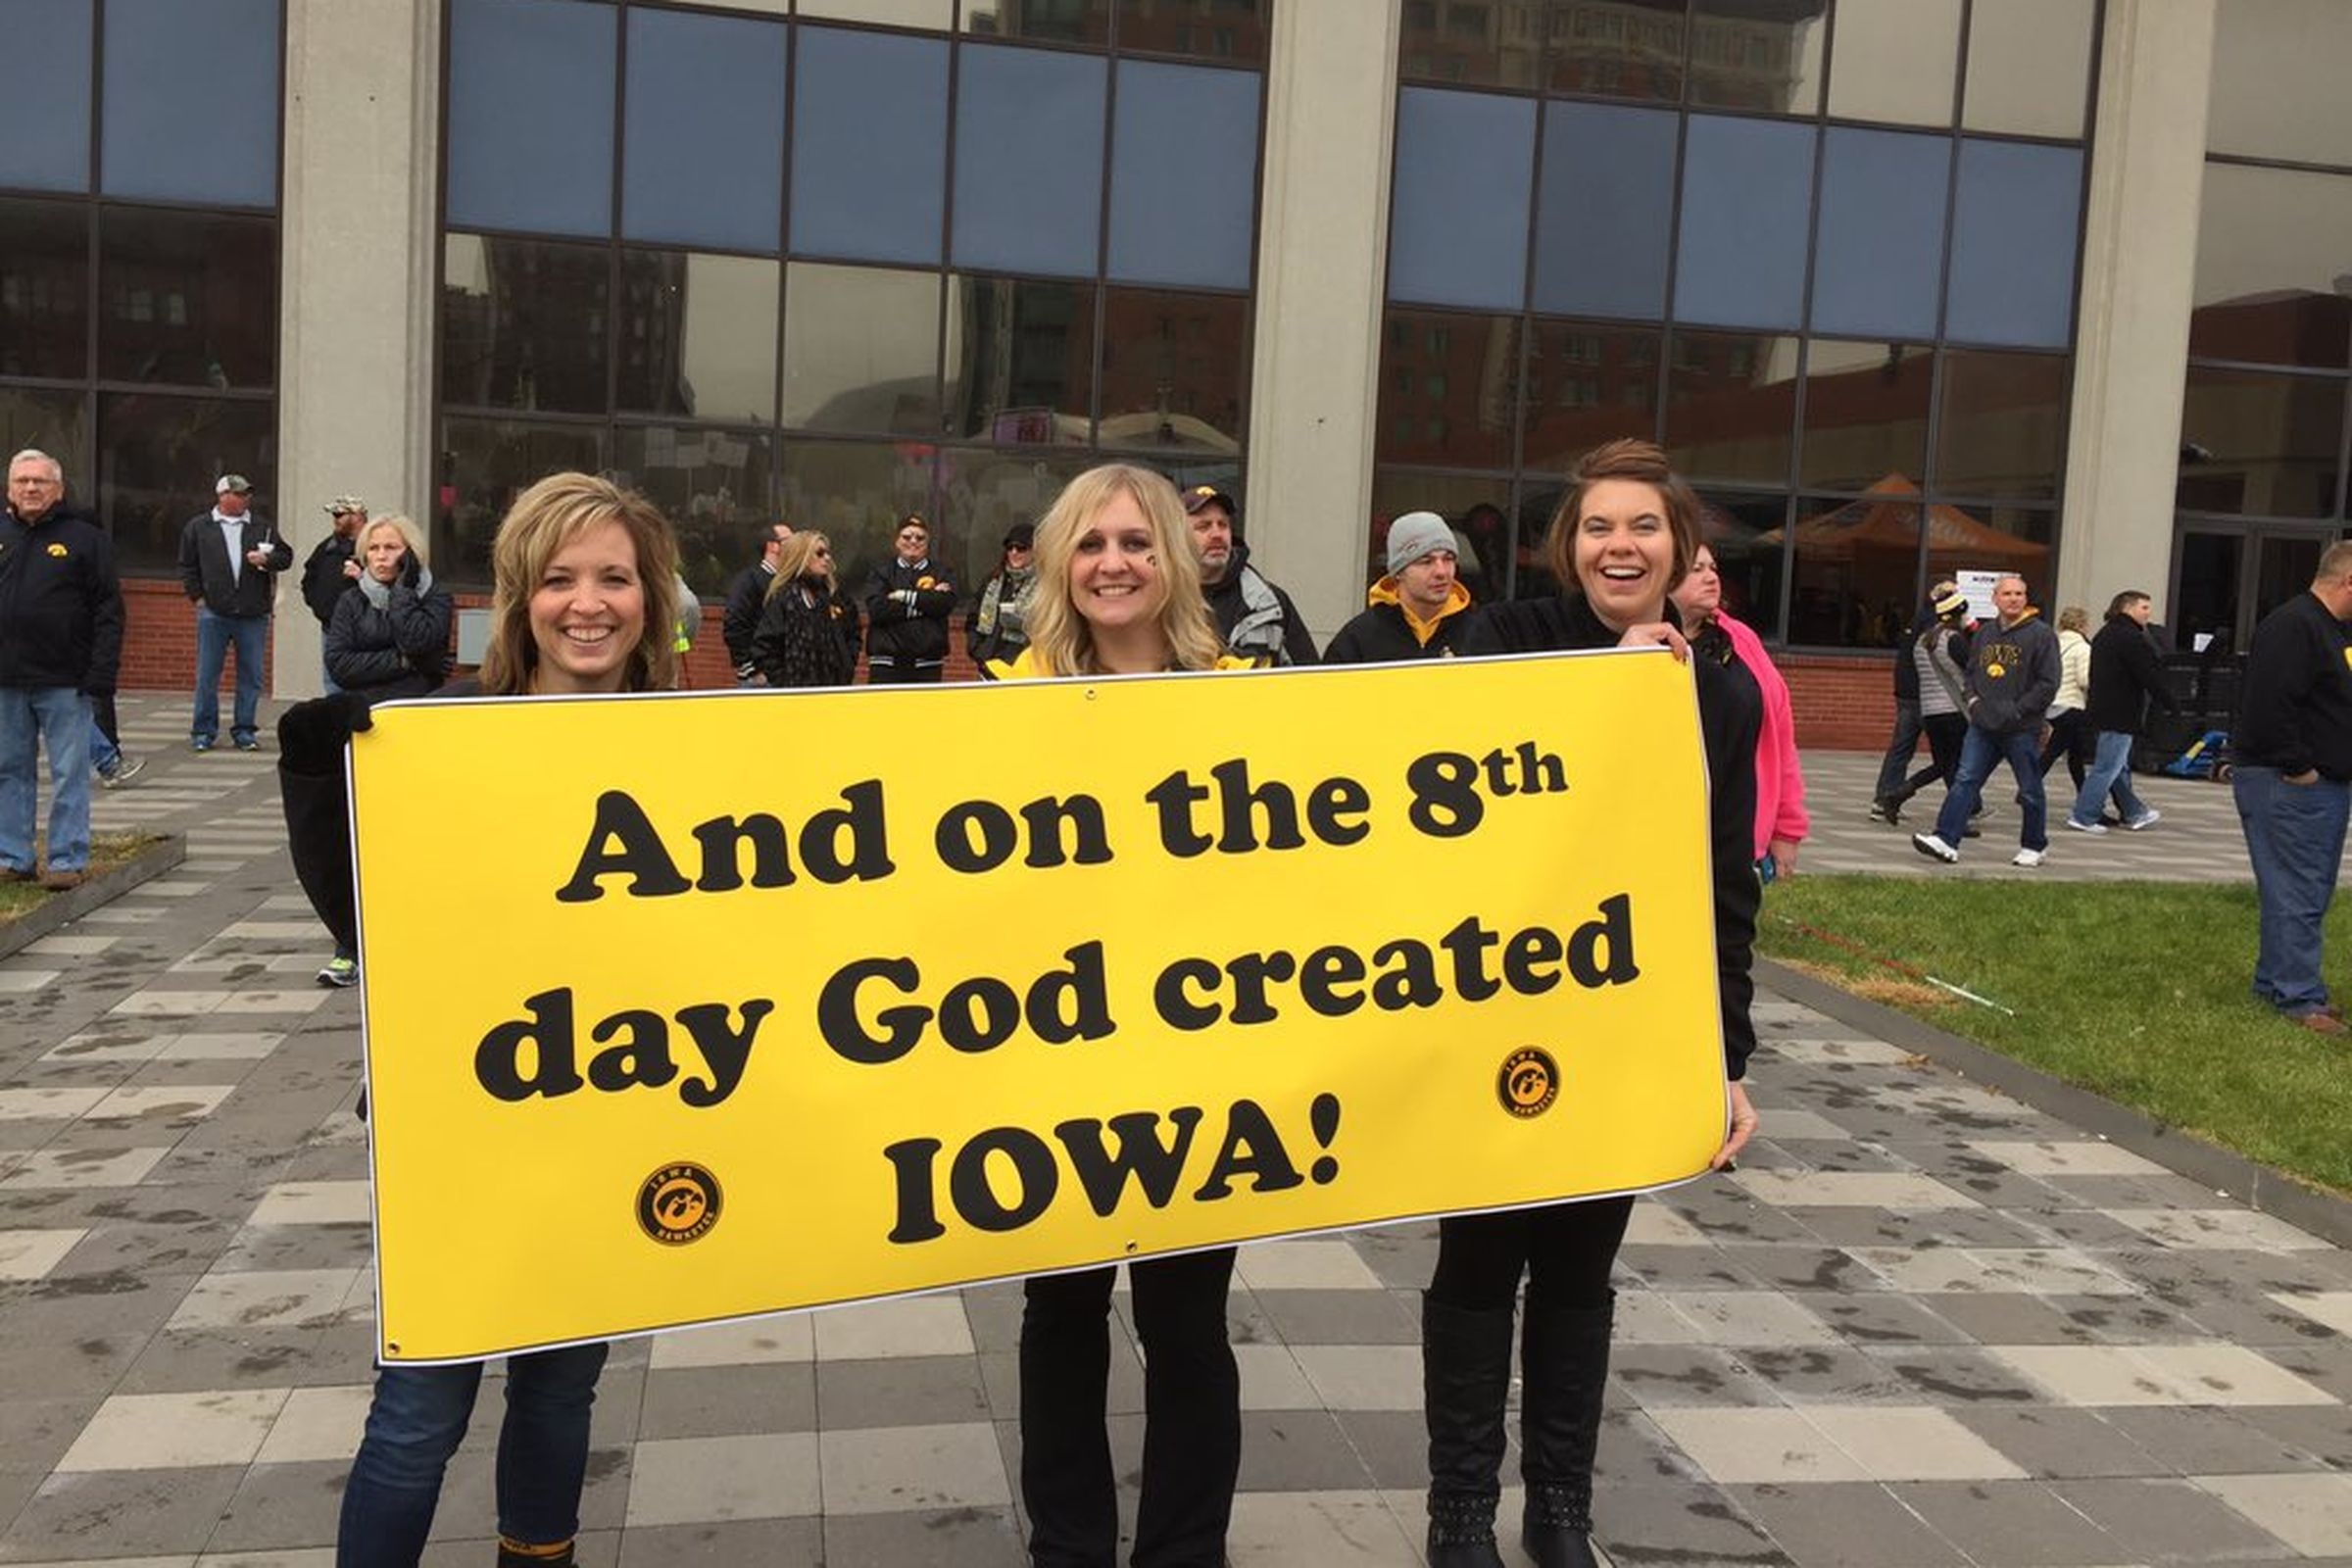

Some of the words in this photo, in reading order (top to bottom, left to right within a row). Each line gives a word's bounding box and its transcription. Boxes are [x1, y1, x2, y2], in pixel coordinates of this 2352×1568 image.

[556, 779, 896, 902] And
[935, 794, 1114, 874] on
[1145, 759, 1370, 858] the
[1406, 741, 1569, 838] 8th
[474, 987, 774, 1108] day
[817, 940, 1117, 1064] God
[1153, 893, 1641, 1031] created
[883, 1093, 1341, 1245] IOWA!
